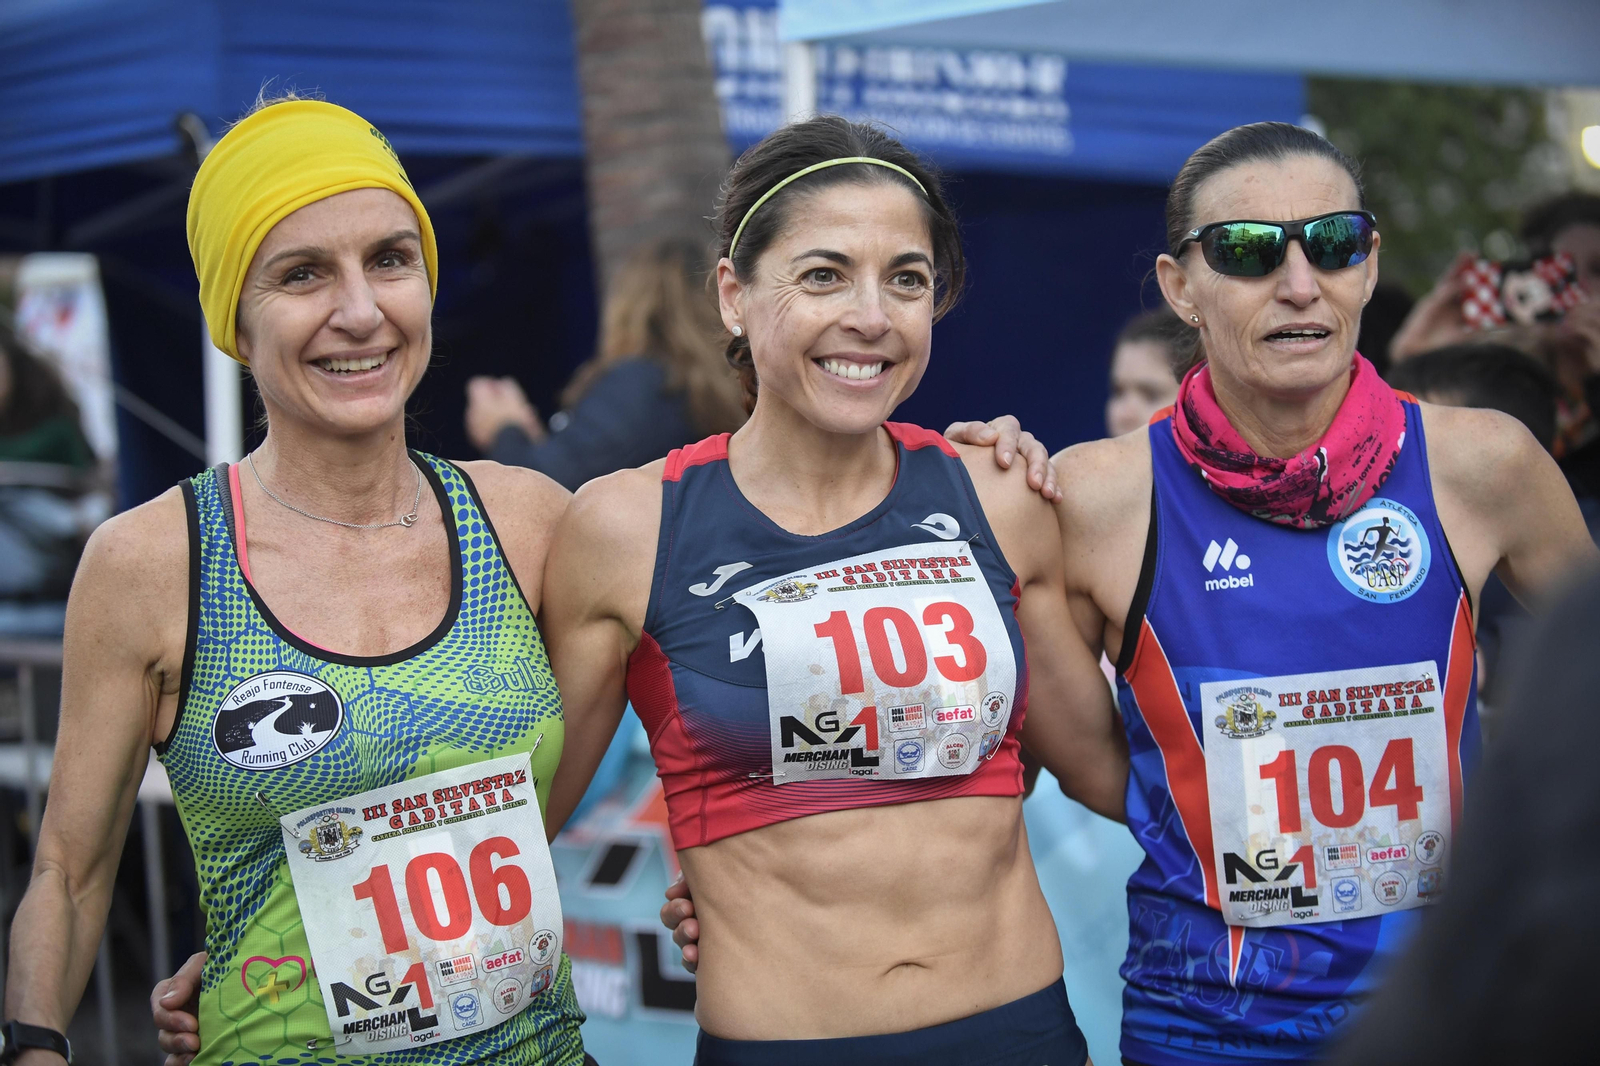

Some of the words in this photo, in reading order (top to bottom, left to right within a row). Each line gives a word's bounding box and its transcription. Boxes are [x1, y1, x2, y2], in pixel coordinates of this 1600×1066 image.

[1380, 500, 1418, 527] ATLÉTICA
[814, 569, 840, 580] III
[842, 563, 878, 576] SAN
[880, 556, 971, 571] SILVESTRE
[842, 568, 961, 585] GADITANA
[1205, 574, 1254, 592] mobel
[1358, 587, 1377, 600] SAN
[1389, 568, 1426, 601] FERNANDO
[814, 601, 988, 695] 103
[232, 685, 260, 706] Reajo
[263, 679, 312, 694] Fontense
[1278, 693, 1302, 708] III
[1307, 688, 1340, 704] SAN
[1346, 678, 1436, 700] SILVESTRE
[936, 708, 973, 722] aefat
[1302, 695, 1422, 719] GADITANA
[242, 750, 288, 764] Running
[288, 738, 316, 756] Club
[784, 749, 850, 762] MERCHAN
[806, 760, 848, 771] DISING
[362, 803, 388, 821] III
[392, 793, 427, 814] SAN
[432, 769, 526, 804] SILVESTRE
[1259, 737, 1424, 834] 104
[389, 789, 514, 829] GADITANA
[1371, 846, 1406, 860] aefat
[352, 836, 532, 955] 106
[1229, 886, 1290, 902] MERCHAN
[1249, 900, 1290, 914] DISING
[486, 950, 522, 970] aefat
[344, 1010, 406, 1034] MERCHAN
[366, 1022, 408, 1042] DISING
